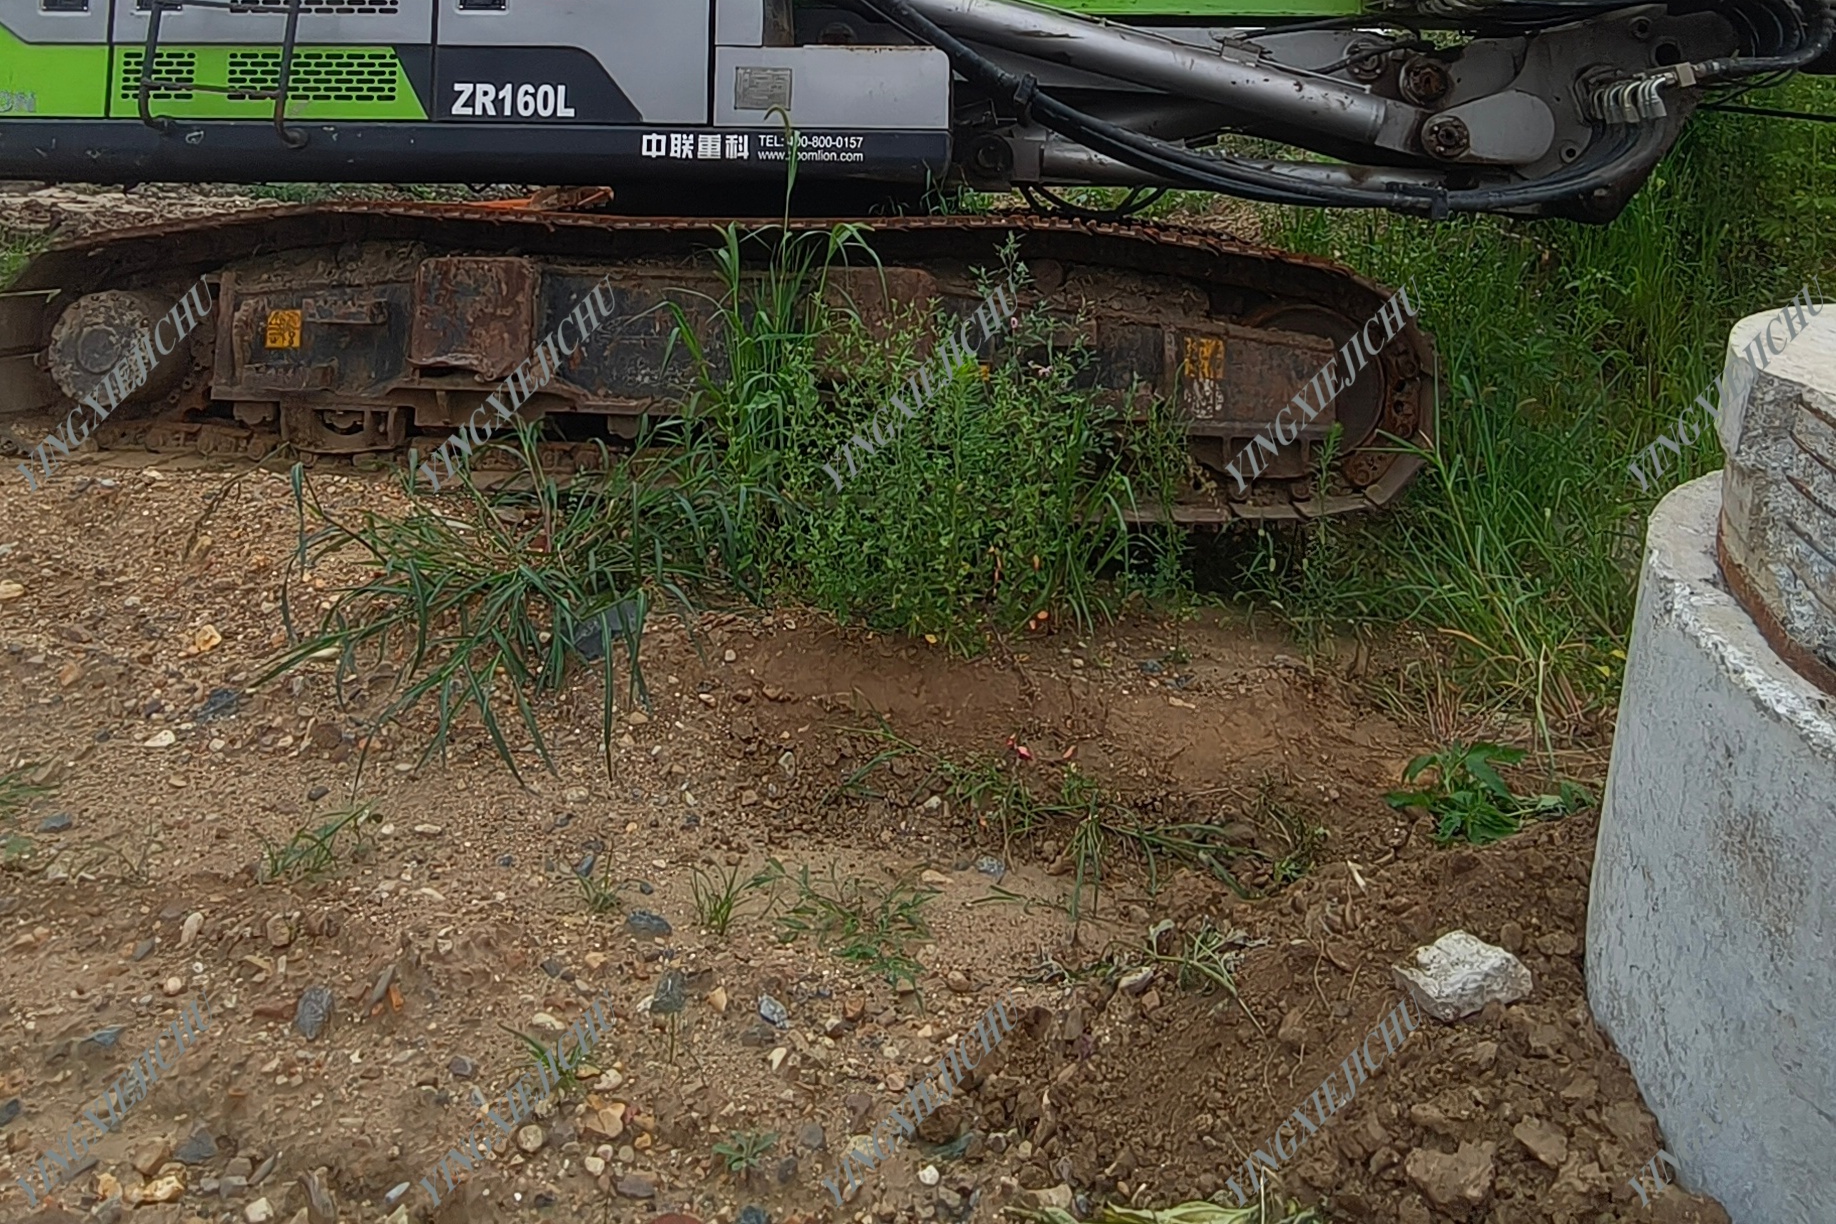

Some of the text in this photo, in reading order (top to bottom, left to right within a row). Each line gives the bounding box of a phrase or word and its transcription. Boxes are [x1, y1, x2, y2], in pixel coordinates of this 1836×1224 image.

[451, 83, 575, 117] ZR160L
[641, 133, 749, 160] 中联重科
[758, 134, 784, 147] TEL:
